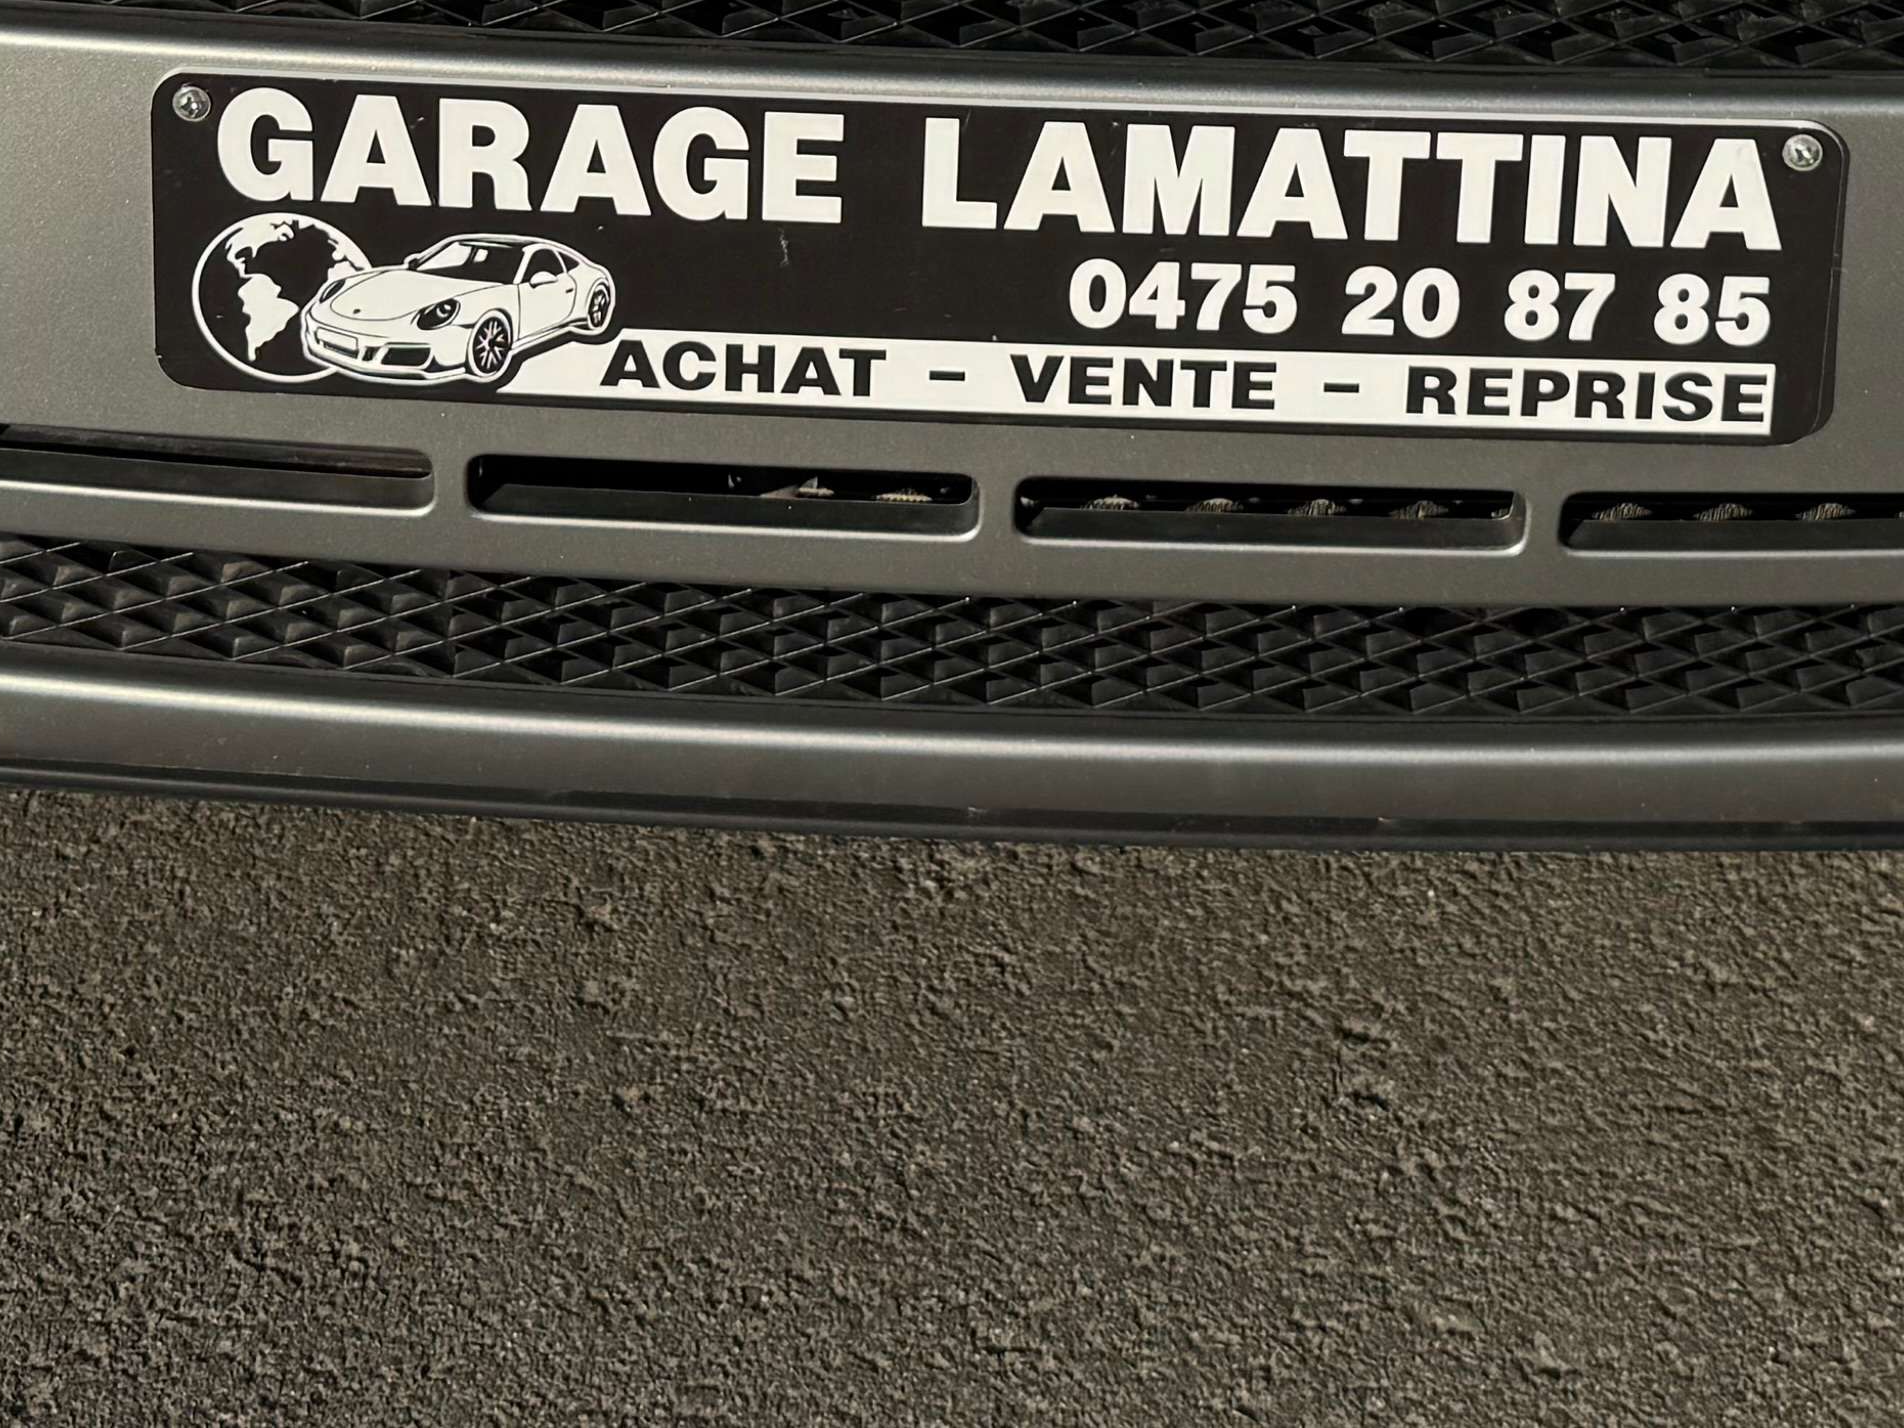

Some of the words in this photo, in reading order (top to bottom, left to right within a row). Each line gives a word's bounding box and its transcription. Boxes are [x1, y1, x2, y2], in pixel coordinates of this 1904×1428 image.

[217, 87, 845, 224] GARAGE
[921, 117, 1782, 251] LAMATTINA
[1069, 259, 1298, 334] 0475
[1341, 265, 1460, 339] 20
[1504, 269, 1616, 341] 87
[1653, 273, 1771, 347] 85
[599, 339, 887, 397] ACHAT
[1010, 354, 1277, 410] VENTE
[1406, 366, 1767, 423] REPRISE
